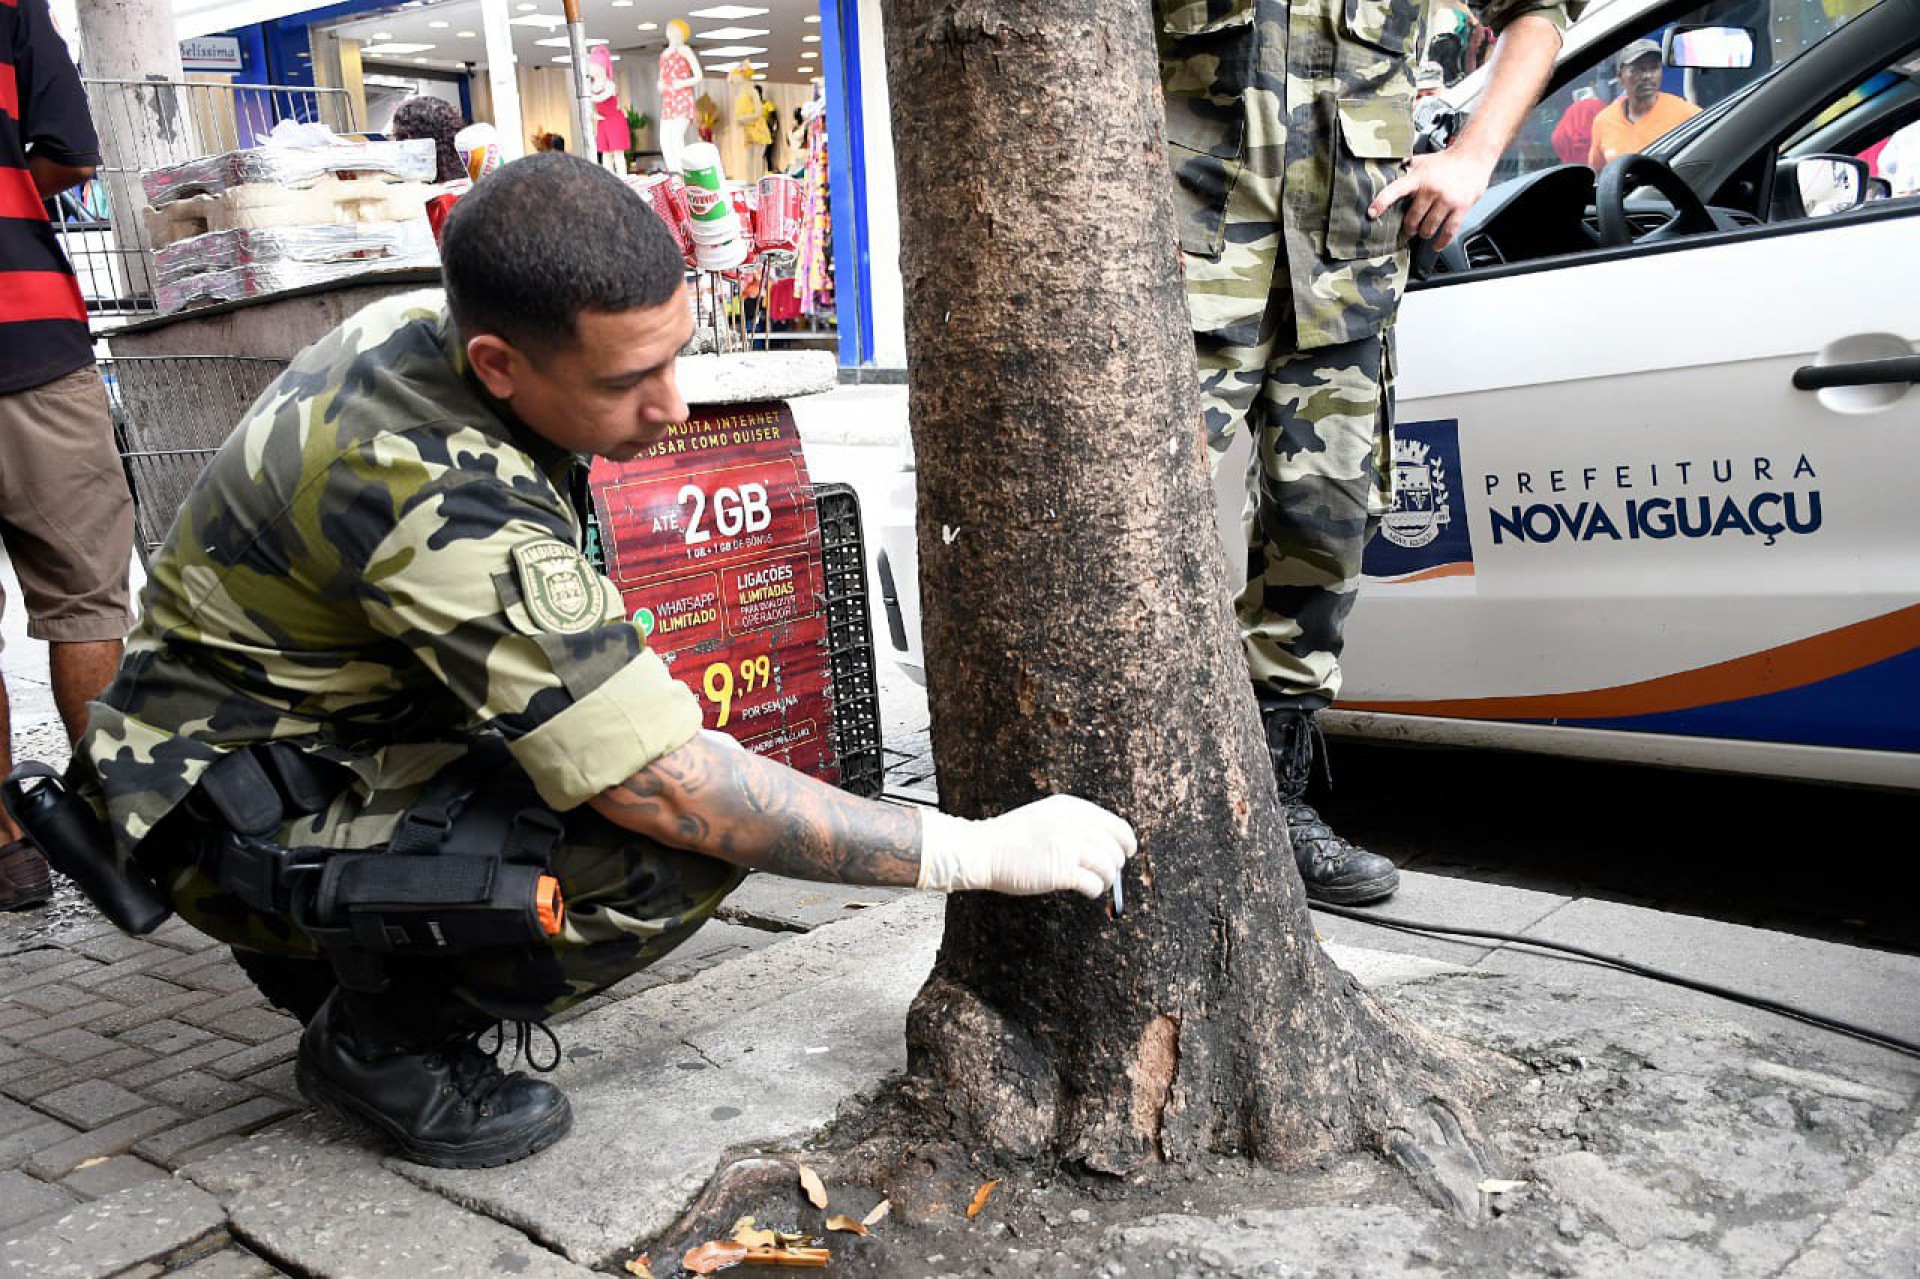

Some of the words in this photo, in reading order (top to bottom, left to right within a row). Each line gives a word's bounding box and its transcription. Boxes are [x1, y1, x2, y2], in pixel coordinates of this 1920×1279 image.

[667, 420, 712, 437] MUITA
[716, 410, 780, 430] INTERNET
[648, 438, 687, 457] USAR
[691, 432, 728, 450] COMO
[733, 426, 781, 444] QUISER
[1485, 453, 1816, 495] PREFEITURA
[652, 509, 679, 533] ATÉ
[1489, 501, 1622, 545] NOVA
[1625, 490, 1822, 547] IGUAÇU
[737, 564, 793, 590] LIGAÇÕES
[656, 591, 715, 617] WHATSAPP
[739, 581, 795, 605] ILIMITADAS
[659, 608, 717, 634] ILIMITADO
[742, 706, 761, 721] POR
